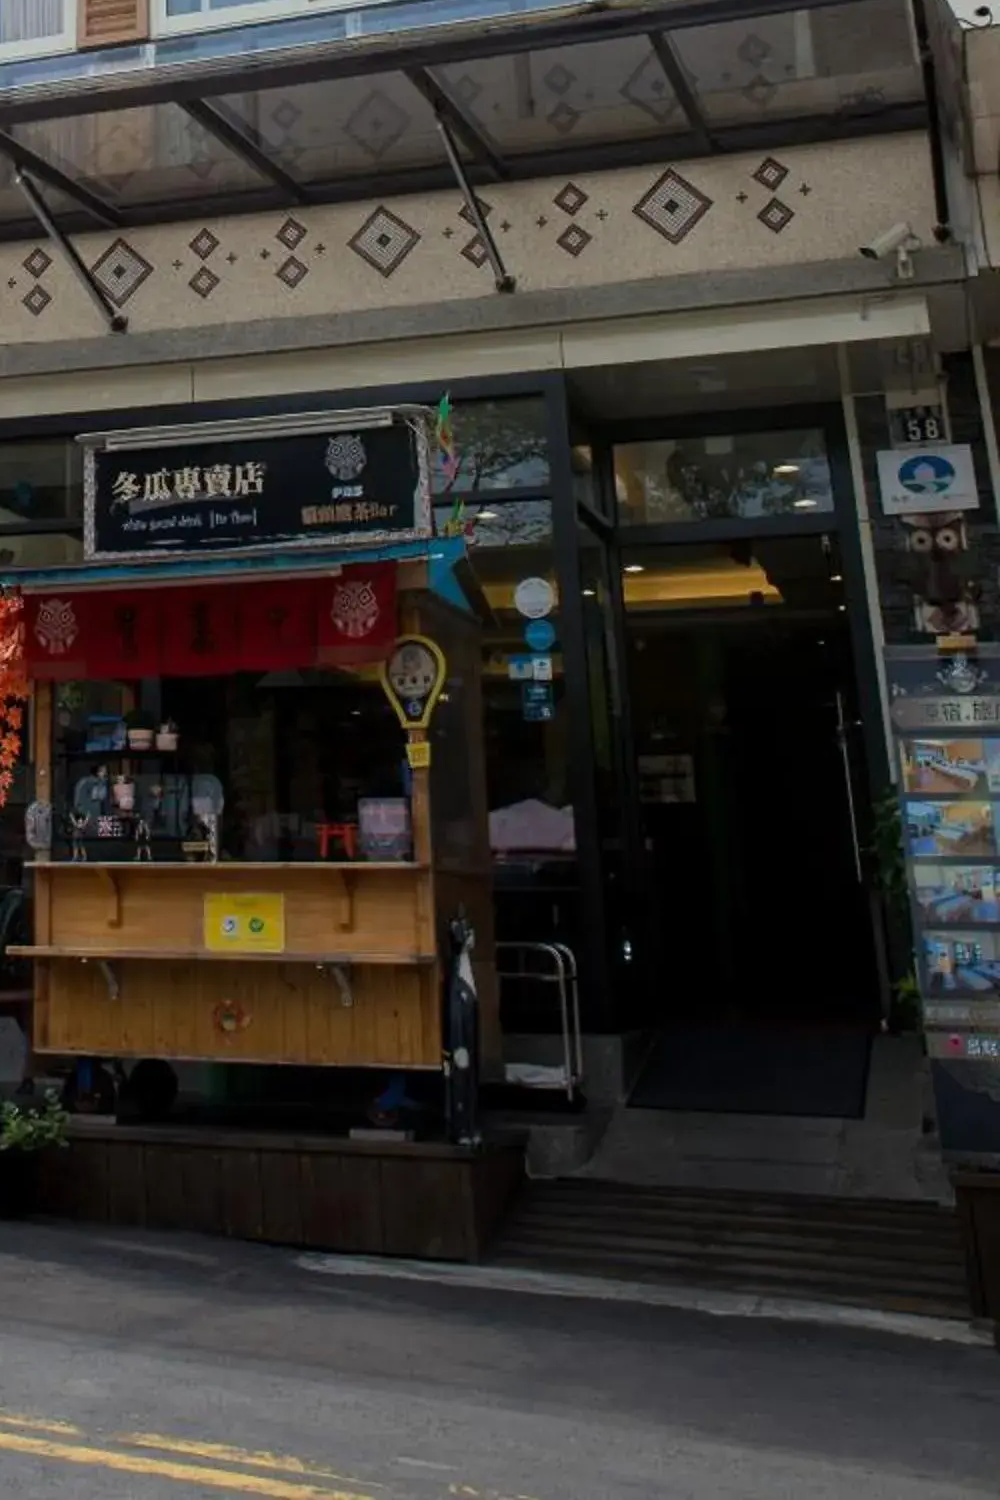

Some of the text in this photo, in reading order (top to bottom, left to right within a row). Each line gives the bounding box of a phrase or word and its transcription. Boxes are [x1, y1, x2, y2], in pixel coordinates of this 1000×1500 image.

[907, 418, 940, 442] 58
[112, 461, 267, 502] 冬瓜專賣店
